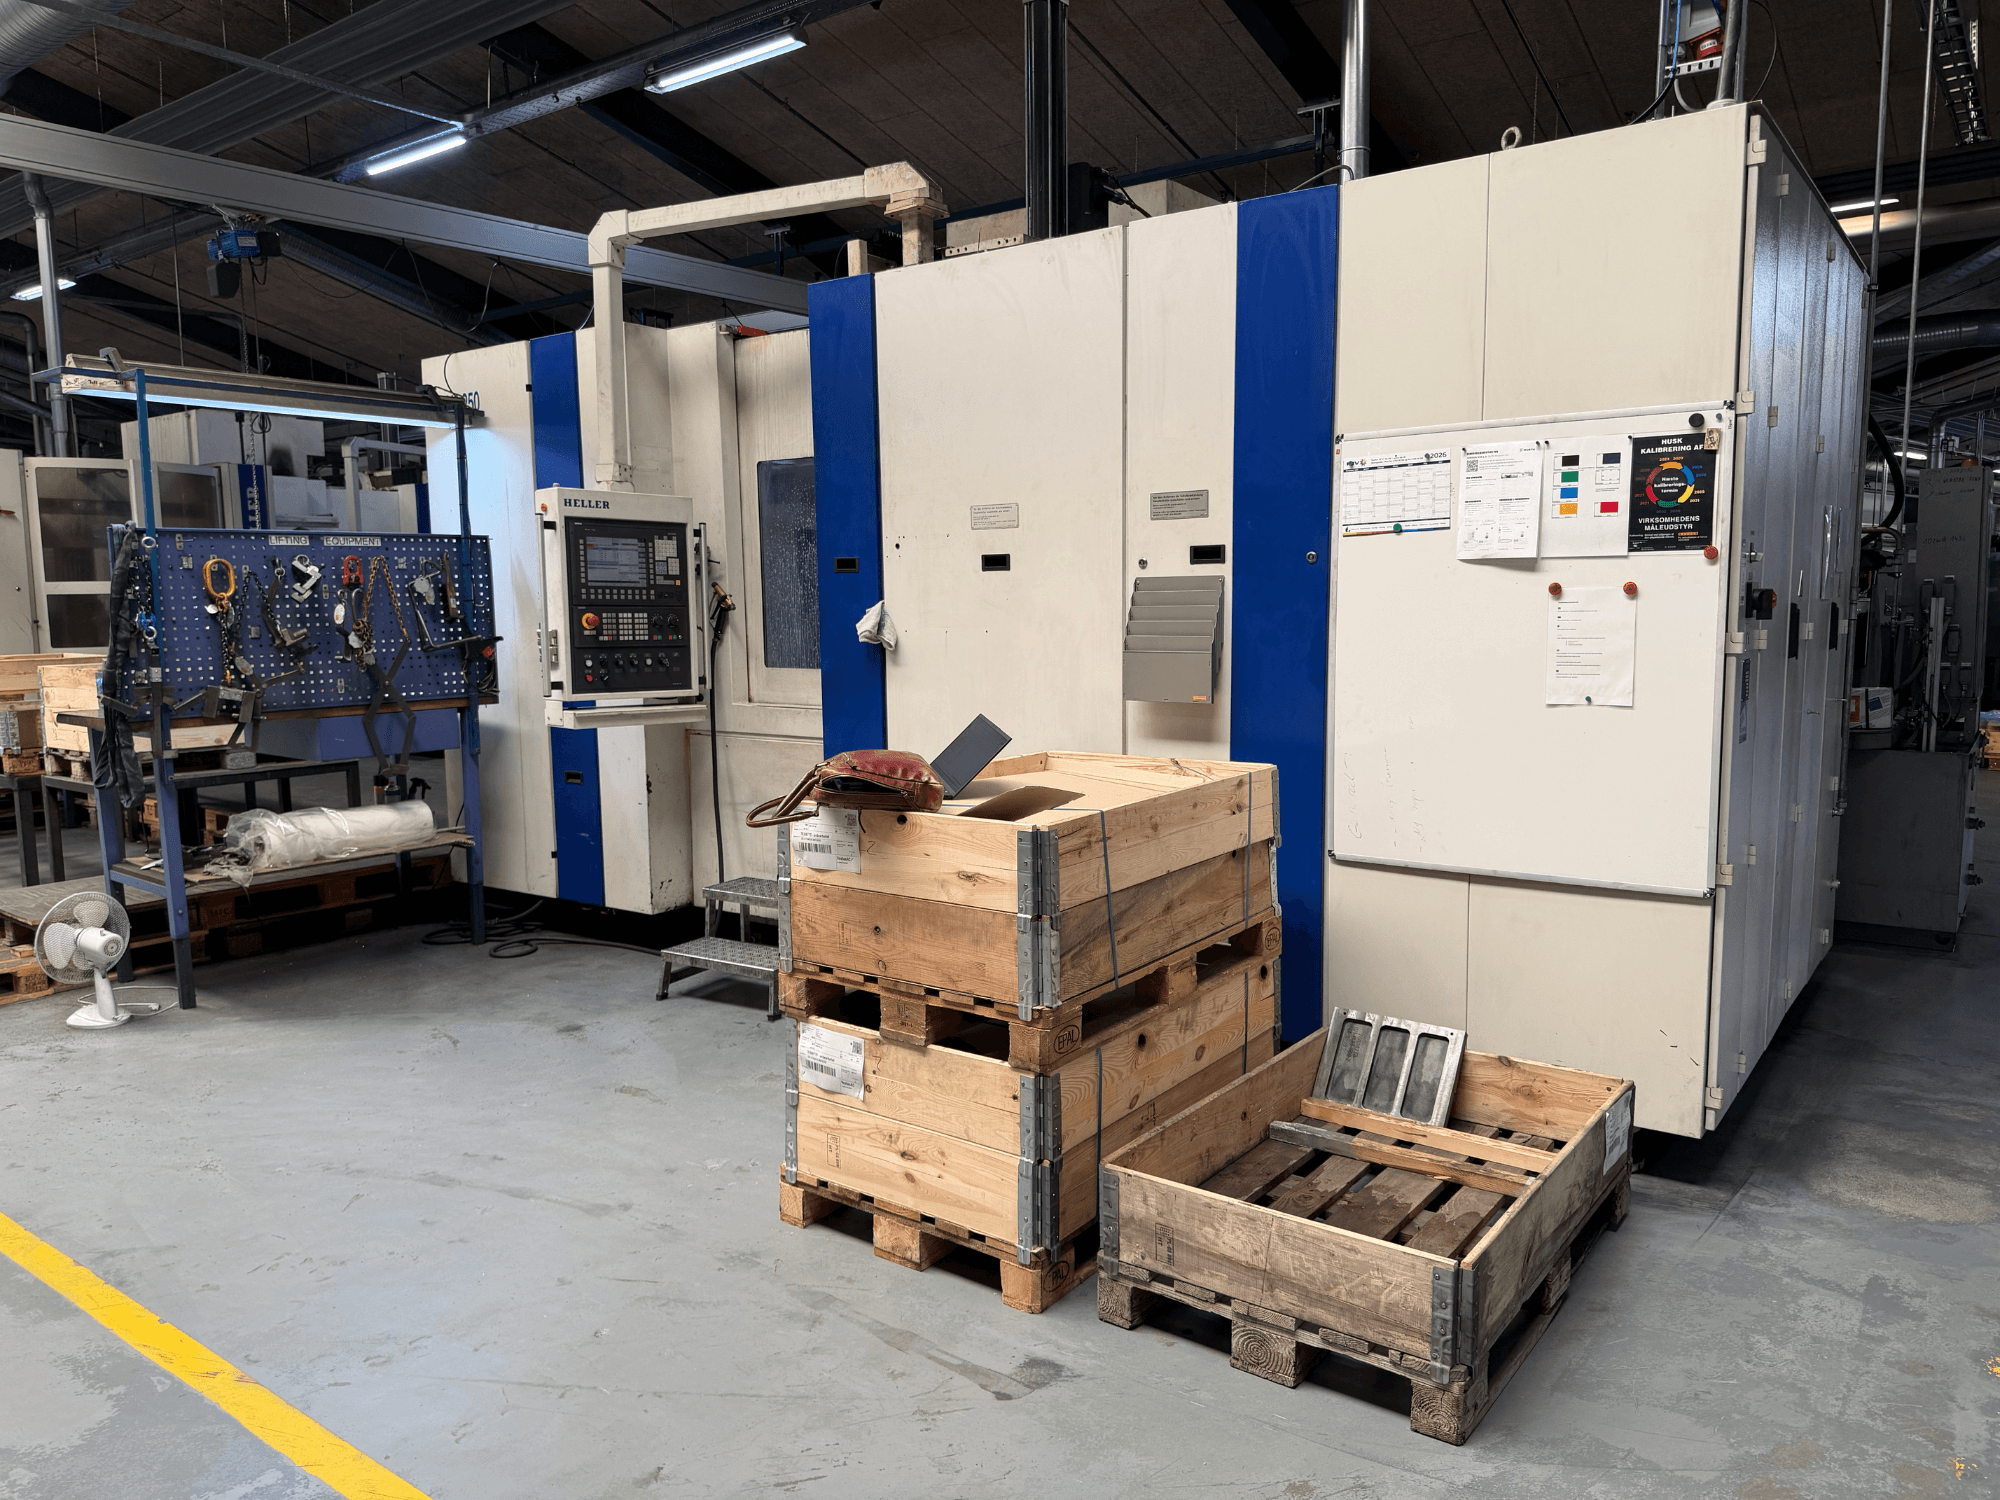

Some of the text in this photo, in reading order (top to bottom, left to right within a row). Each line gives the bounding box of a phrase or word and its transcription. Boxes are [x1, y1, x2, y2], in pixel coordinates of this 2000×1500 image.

[1640, 445, 1692, 454] KALIBRERING
[563, 498, 611, 510] HELLER
[1638, 515, 1700, 524] VIRKSOMHEDENS
[1644, 523, 1693, 531] MÅLEUDSTYR
[269, 536, 380, 546] LIFTING EQUIPMENT
[1057, 1029, 1078, 1051] EPAL
